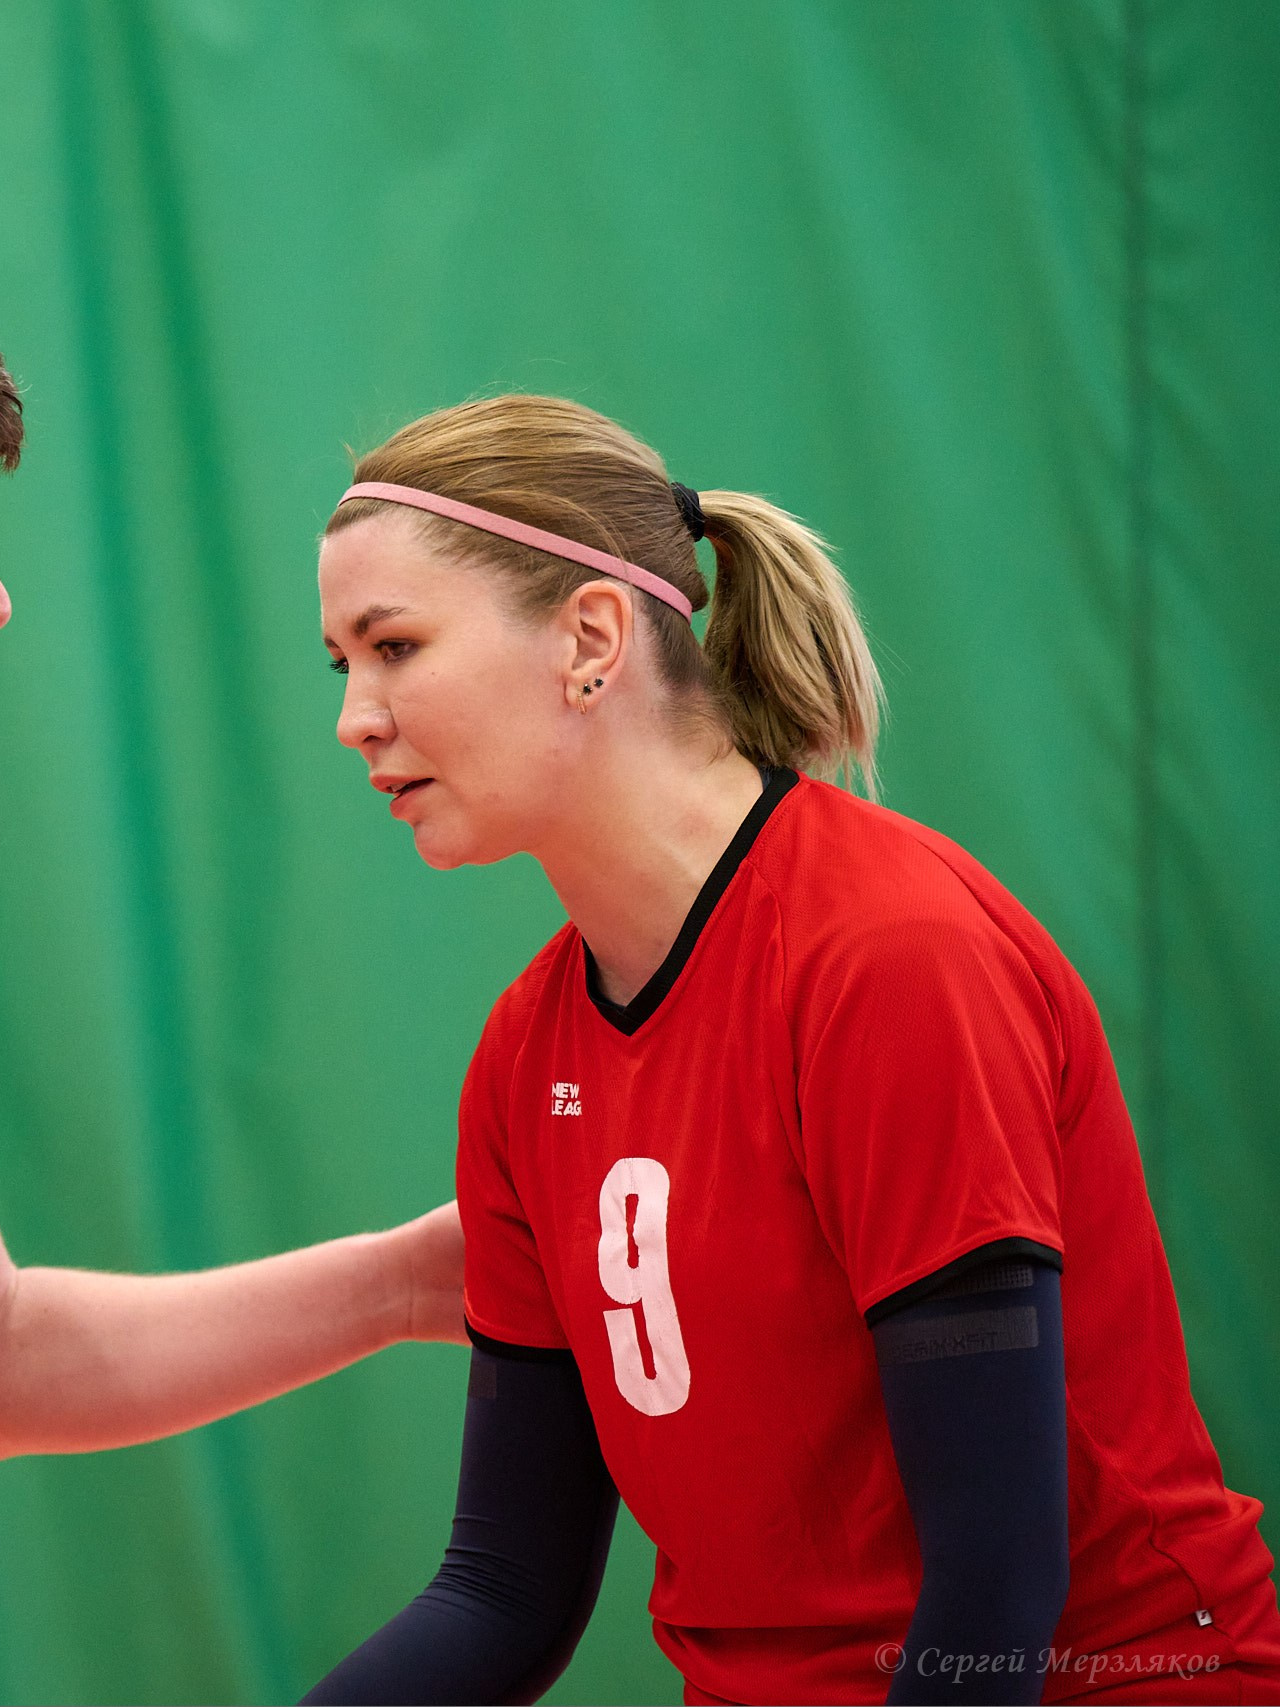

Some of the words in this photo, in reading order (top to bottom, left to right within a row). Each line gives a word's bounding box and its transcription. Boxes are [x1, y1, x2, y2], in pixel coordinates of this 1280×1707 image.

[551, 1082, 580, 1099] NEW
[551, 1099, 583, 1116] LEAG
[598, 1157, 691, 1417] 9
